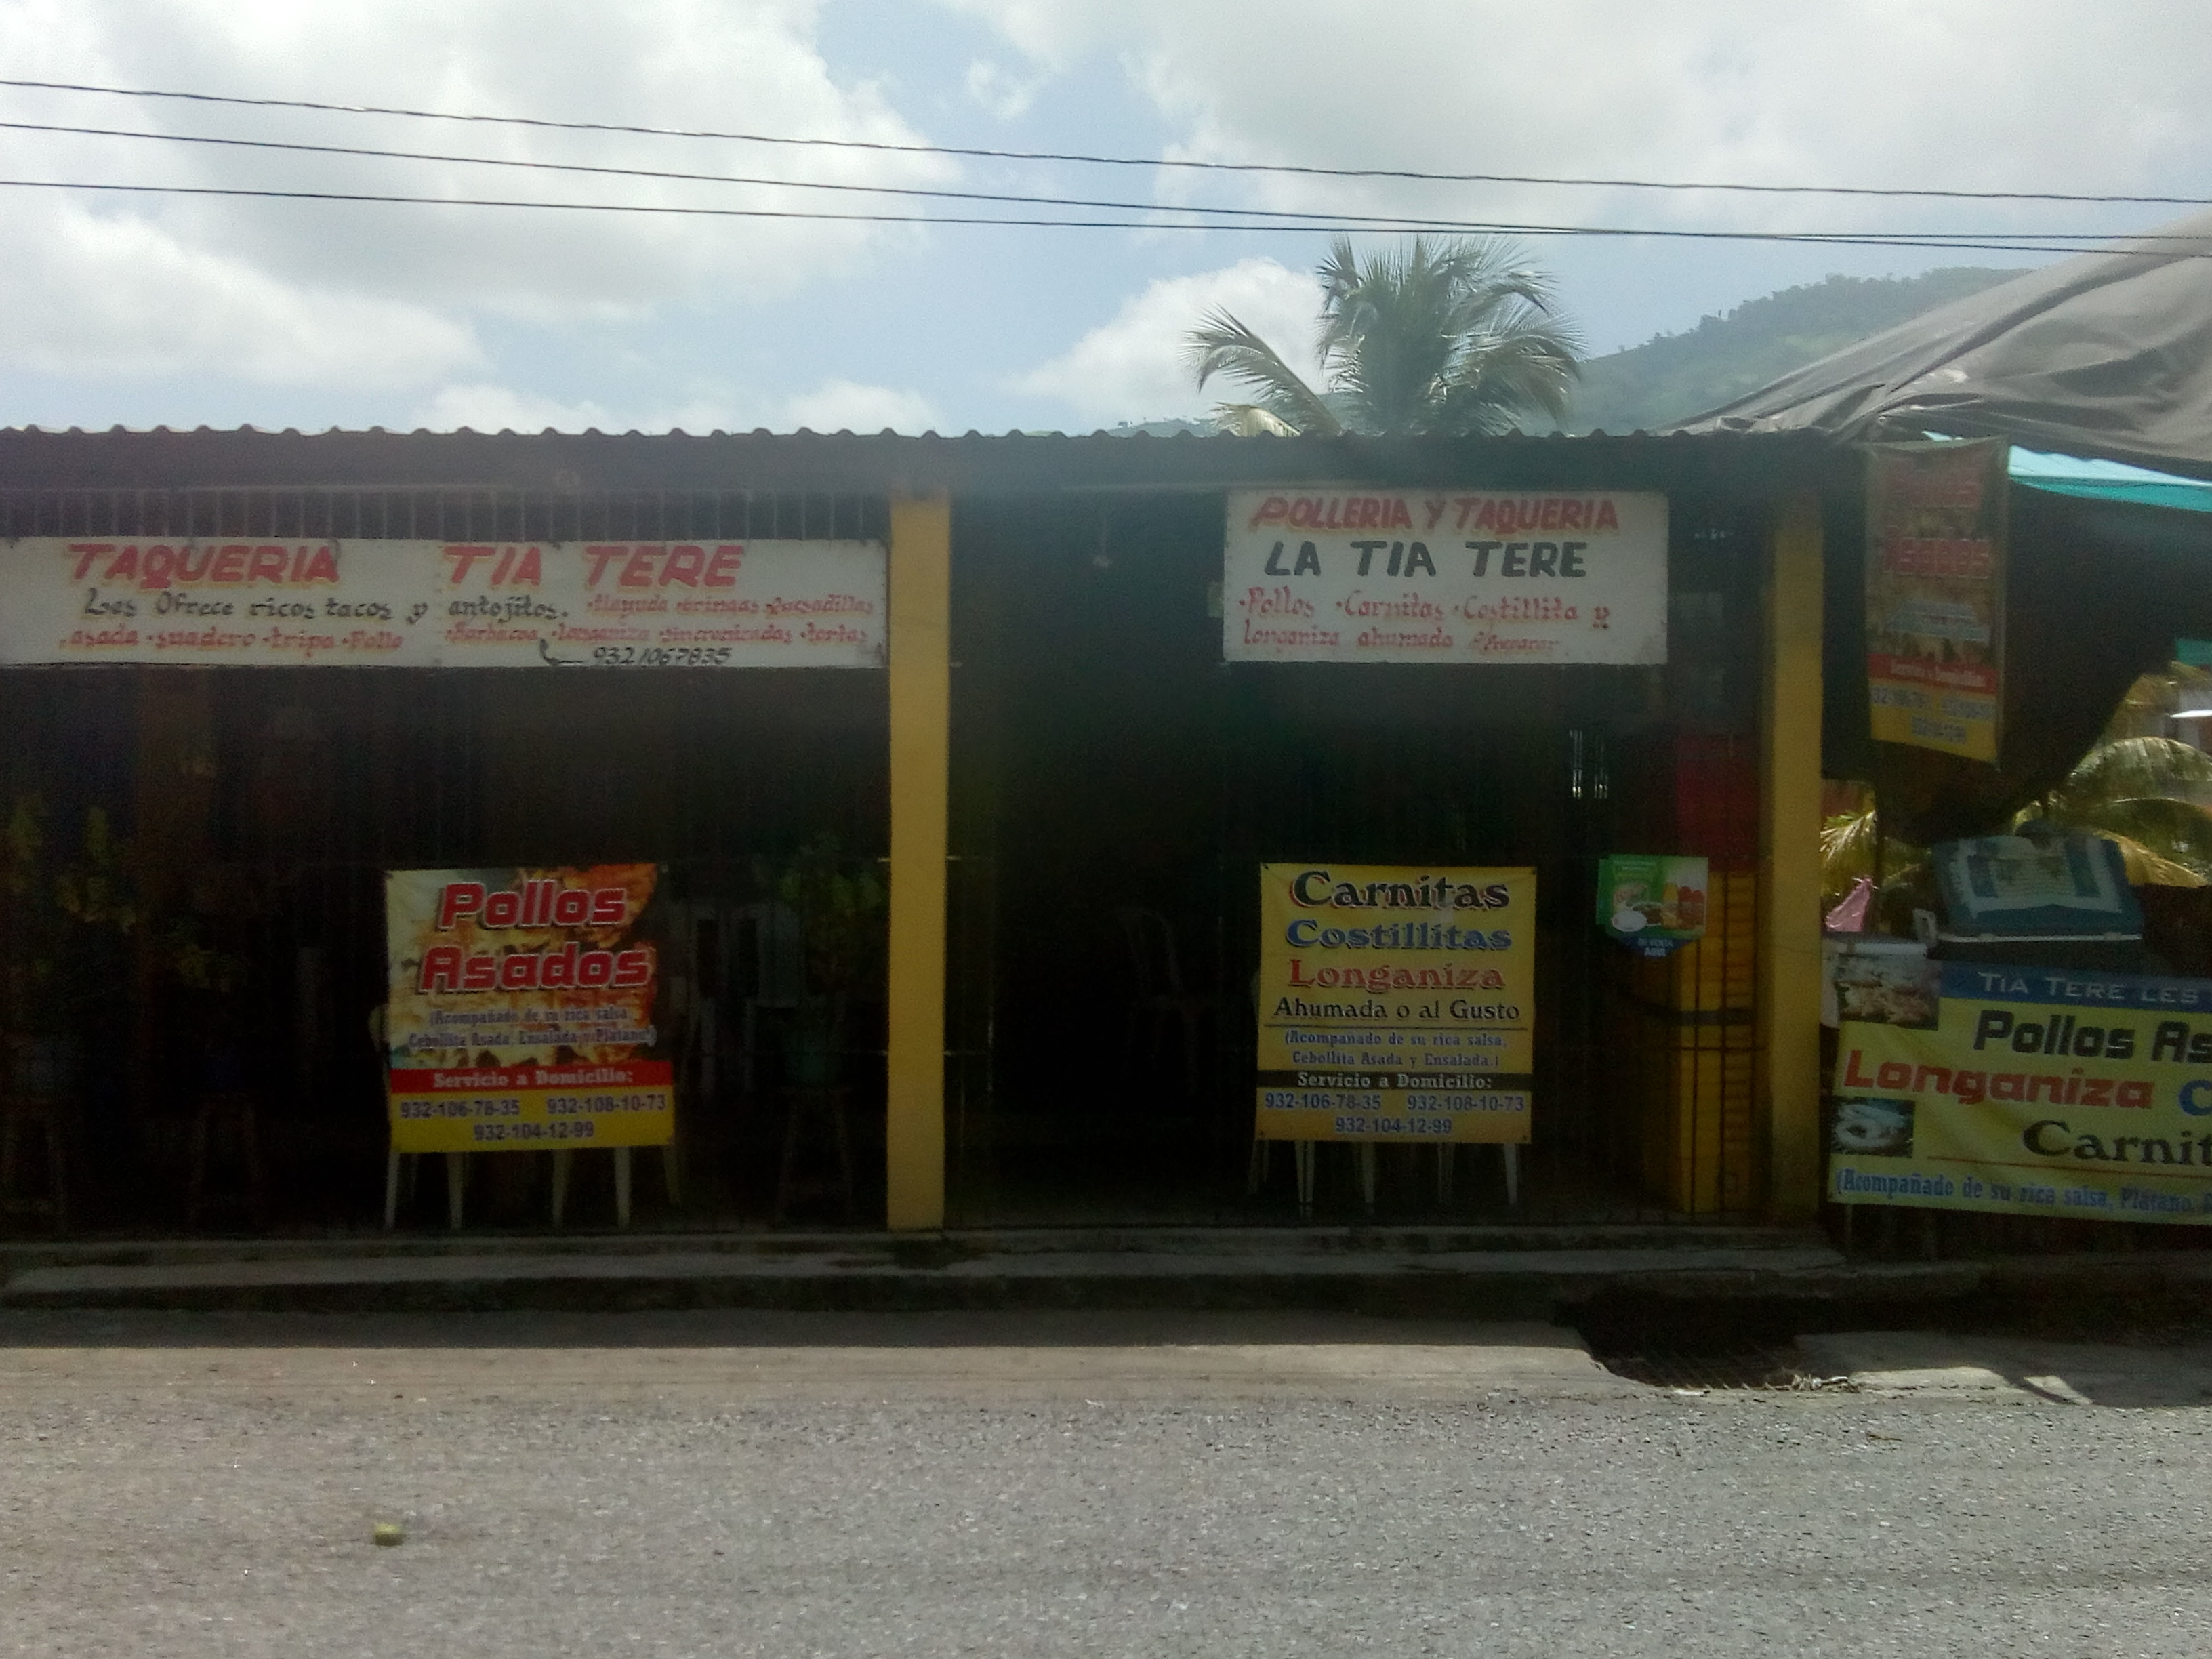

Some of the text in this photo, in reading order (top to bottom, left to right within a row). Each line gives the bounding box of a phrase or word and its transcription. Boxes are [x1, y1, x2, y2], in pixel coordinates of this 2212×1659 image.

[1250, 497, 1619, 534] POLLERIA Y TAQUERIA
[68, 544, 743, 588] TAQUERIA TIA TERE
[1264, 541, 1588, 577] LA TIA TERE
[249, 597, 314, 619] ricos
[325, 597, 393, 621] tacos
[406, 602, 428, 625] y
[1290, 869, 1511, 910] Carnitas
[437, 879, 628, 930] Pollos
[1284, 919, 1513, 950] Costillitas
[417, 941, 650, 994] Asados
[1288, 958, 1507, 994] Longaniza
[2045, 976, 2126, 1000] TERE
[2140, 985, 2200, 1004] LES
[1273, 997, 1520, 1020] Ahumada o al Gusto
[1388, 1031, 1404, 1046] de
[1410, 1034, 1427, 1046] su
[1432, 1031, 1460, 1046] rica
[1973, 1009, 2136, 1060] Pollos
[1292, 1050, 1355, 1066] Cebollita
[1360, 1052, 1403, 1066] Asada
[1409, 1055, 1418, 1069] y
[432, 1071, 510, 1090] Servicio
[516, 1073, 529, 1086] a
[1297, 1071, 1493, 1090] Servicio a Domicilio:
[1843, 1048, 2156, 1109] Longaniza
[400, 1093, 667, 1118] 932-106-78-35 932-108-10-73
[1264, 1092, 1525, 1112] 932-106-78-35 932-108-10-73
[473, 1120, 595, 1141] 932-104-12-99
[1335, 1116, 1452, 1134] 932-104-12-99
[1962, 1175, 1983, 1198] de
[1990, 1181, 2011, 1200] su
